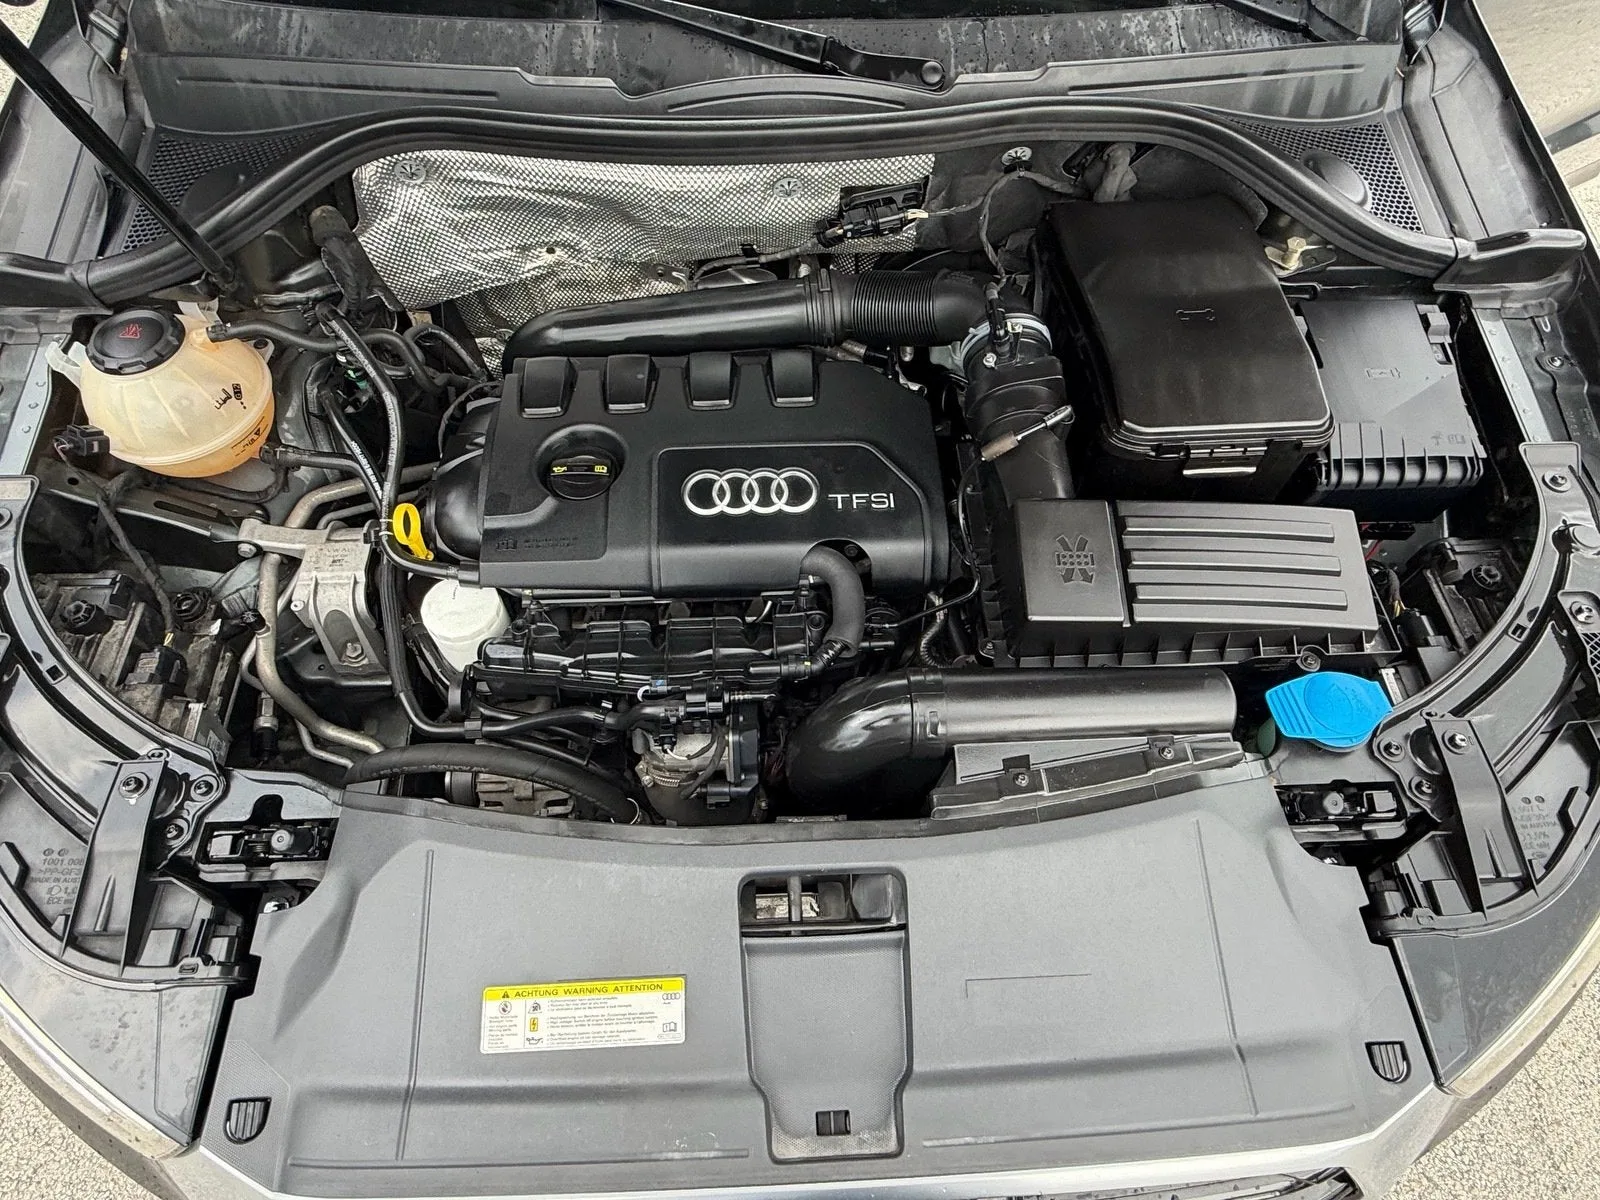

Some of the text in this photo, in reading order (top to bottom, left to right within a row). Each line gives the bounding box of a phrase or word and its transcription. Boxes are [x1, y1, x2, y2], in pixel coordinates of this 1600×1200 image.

[828, 492, 894, 509] TFSI
[515, 983, 663, 998] ACHTUNG WARNING ATTENTION
